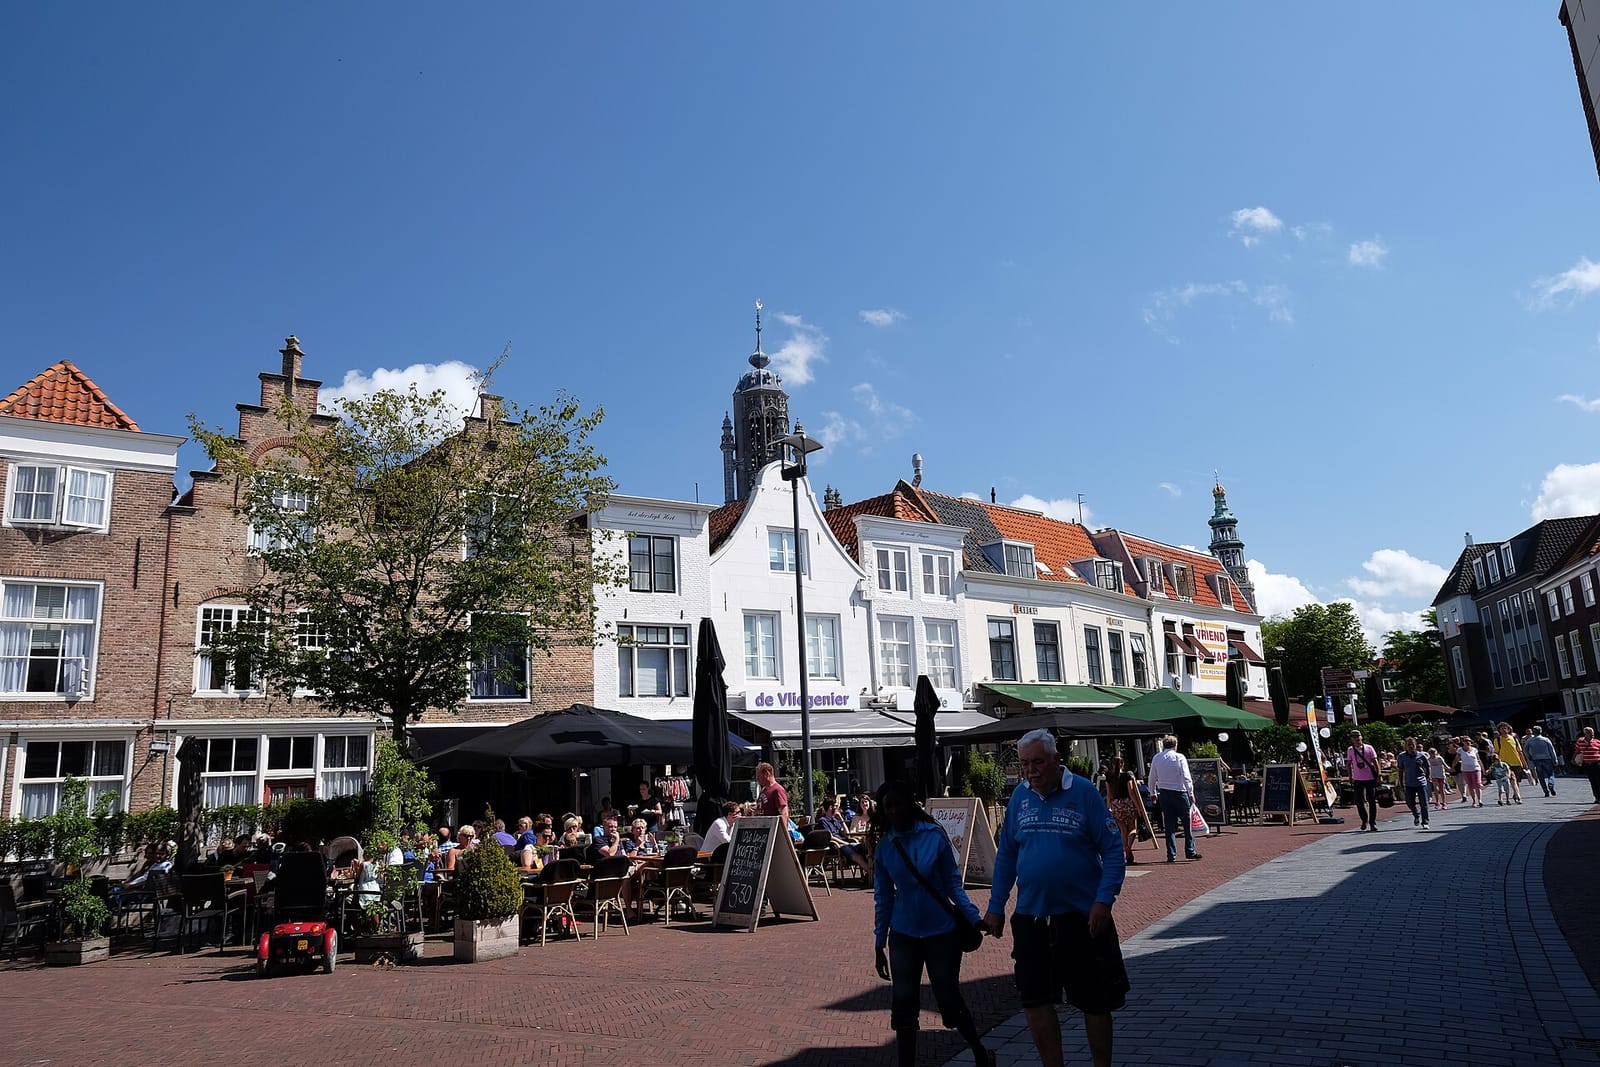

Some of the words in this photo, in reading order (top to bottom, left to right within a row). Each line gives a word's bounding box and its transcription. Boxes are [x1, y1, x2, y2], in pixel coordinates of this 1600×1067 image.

[1195, 628, 1226, 643] VRIEND
[1198, 650, 1228, 663] SHAP
[755, 692, 774, 707] de
